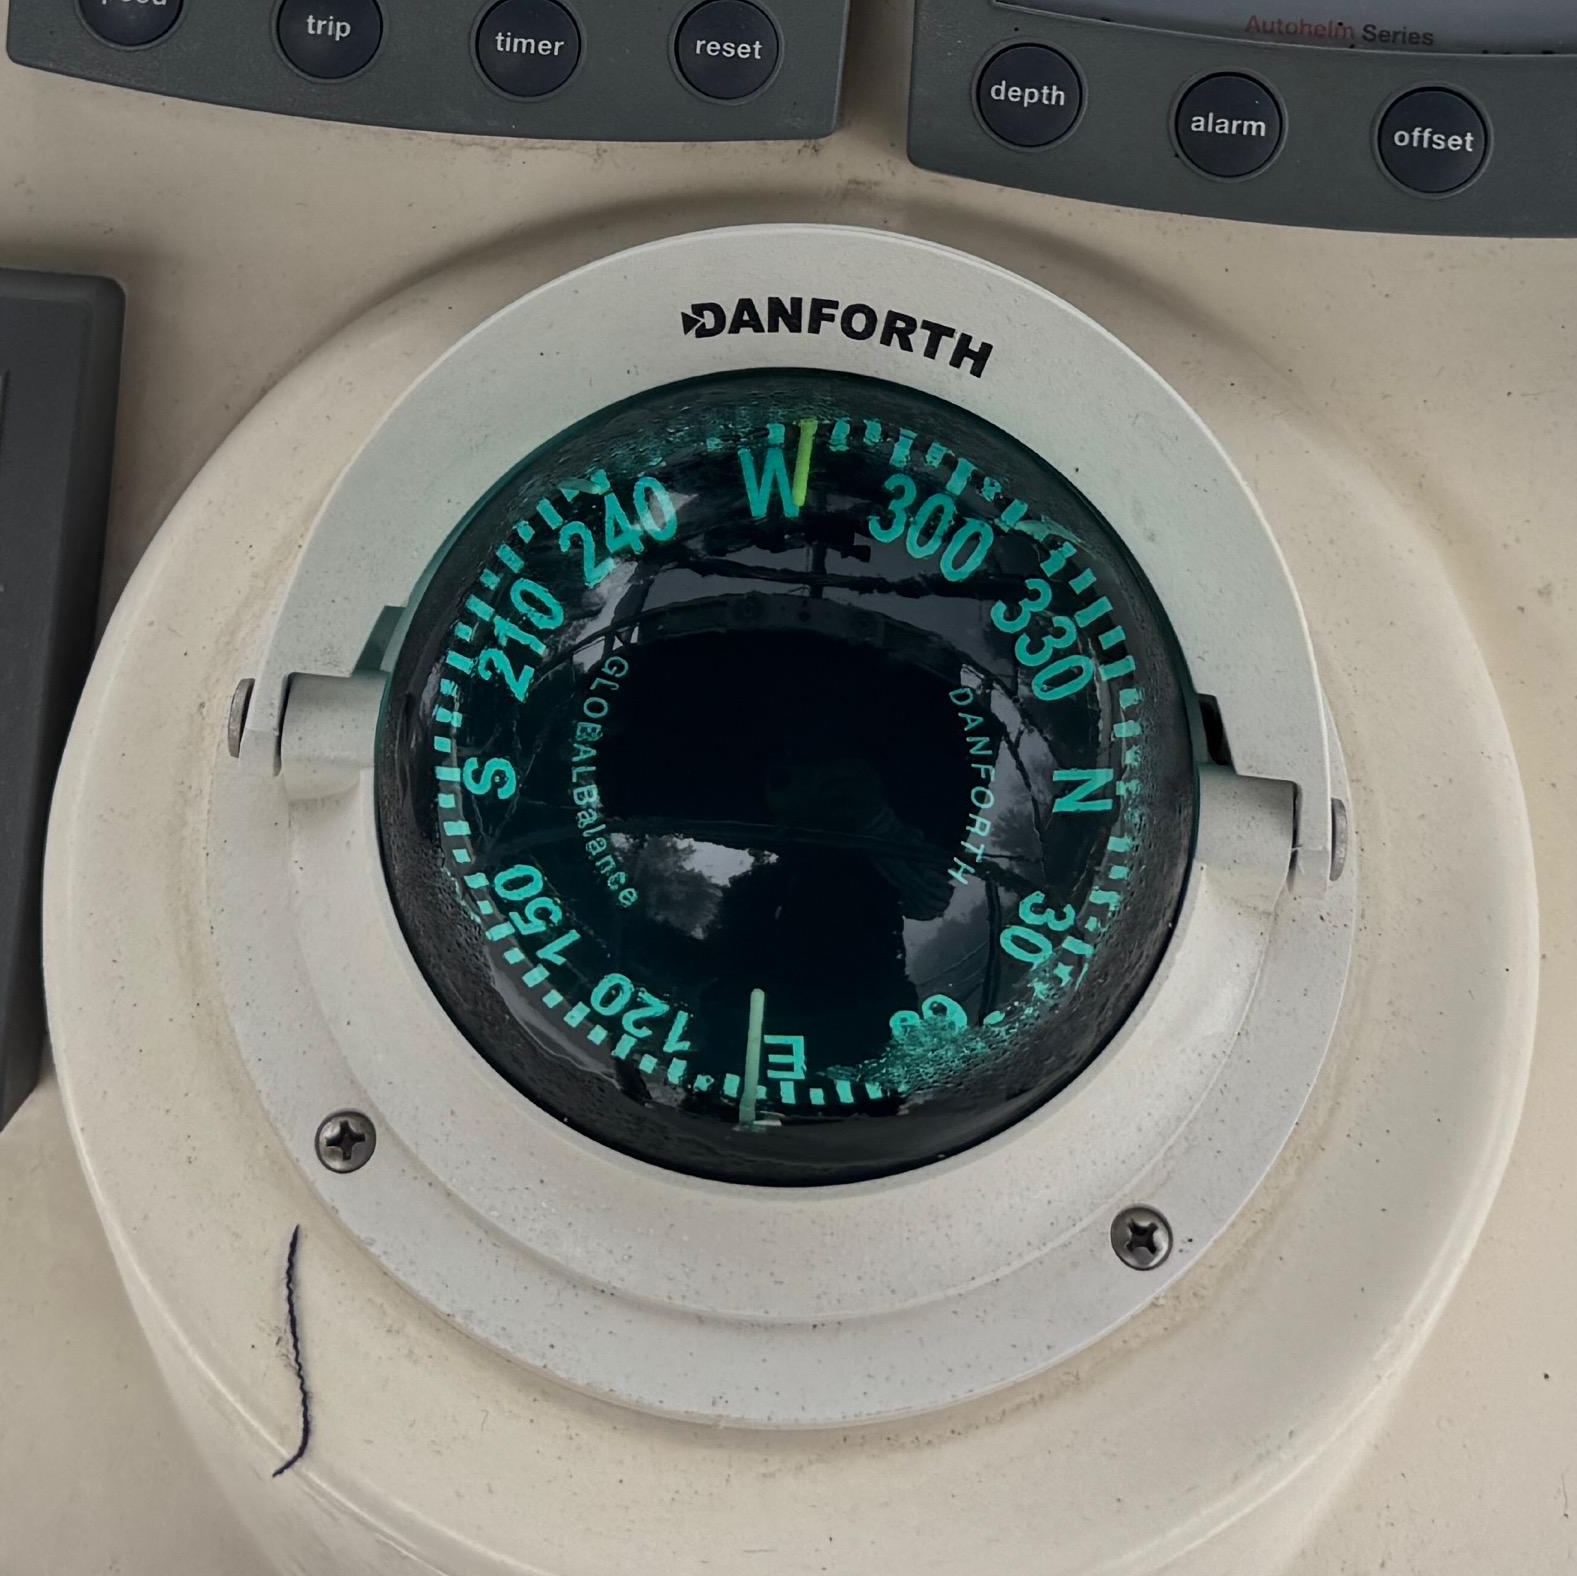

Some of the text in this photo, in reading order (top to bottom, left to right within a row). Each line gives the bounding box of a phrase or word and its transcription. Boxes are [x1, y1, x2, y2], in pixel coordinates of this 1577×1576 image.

[306, 11, 352, 42] trip
[494, 30, 564, 58] timer
[694, 34, 763, 62] reset
[1244, 13, 1436, 49] Autohelm Series
[989, 79, 1066, 109] depth
[1190, 111, 1266, 138] alarm
[1392, 126, 1474, 154] offset
[681, 296, 994, 379] DANFORTH
[557, 475, 679, 587] 240
[867, 473, 995, 583] 300
[476, 585, 566, 704] 210
[989, 577, 1096, 703] 330
[461, 755, 517, 801] S
[948, 687, 996, 886] DANFORTH
[1051, 766, 1115, 815] N
[492, 862, 583, 967] 150
[998, 887, 1076, 970] 30
[588, 971, 691, 1057] 120
[762, 1032, 807, 1081] E
